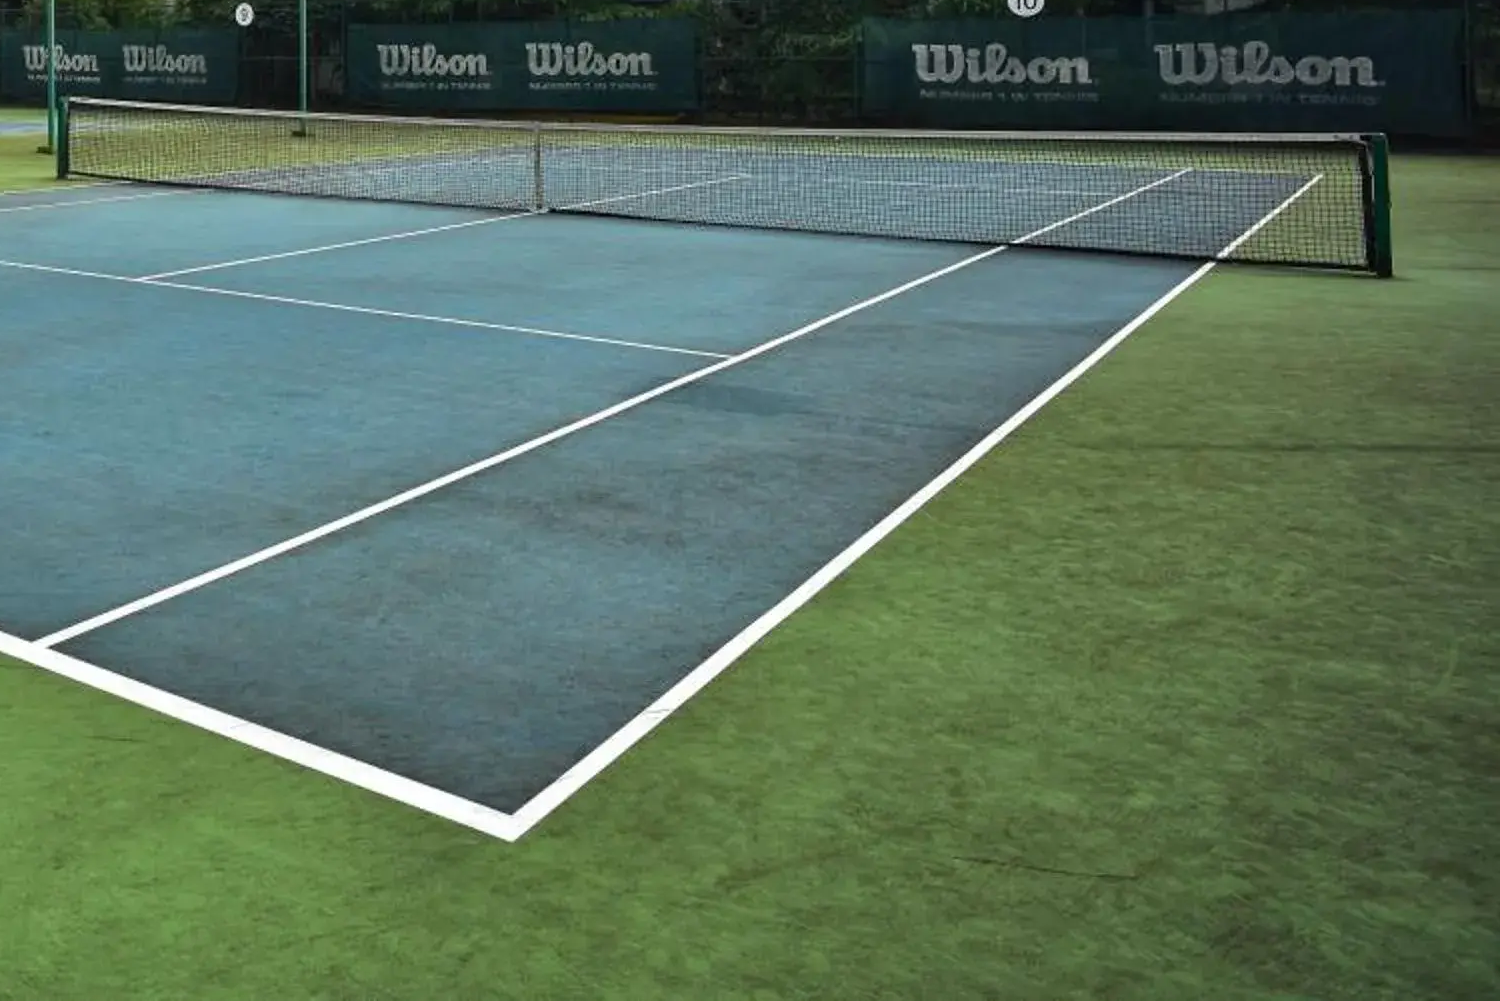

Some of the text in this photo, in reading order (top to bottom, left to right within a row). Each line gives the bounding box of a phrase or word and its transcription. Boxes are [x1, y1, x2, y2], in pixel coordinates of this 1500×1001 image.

[121, 44, 208, 74] Wilson
[376, 42, 491, 76] Wilson
[524, 41, 656, 76] Wilson
[911, 42, 1093, 84] Wilson
[1153, 40, 1382, 87] Wilson
